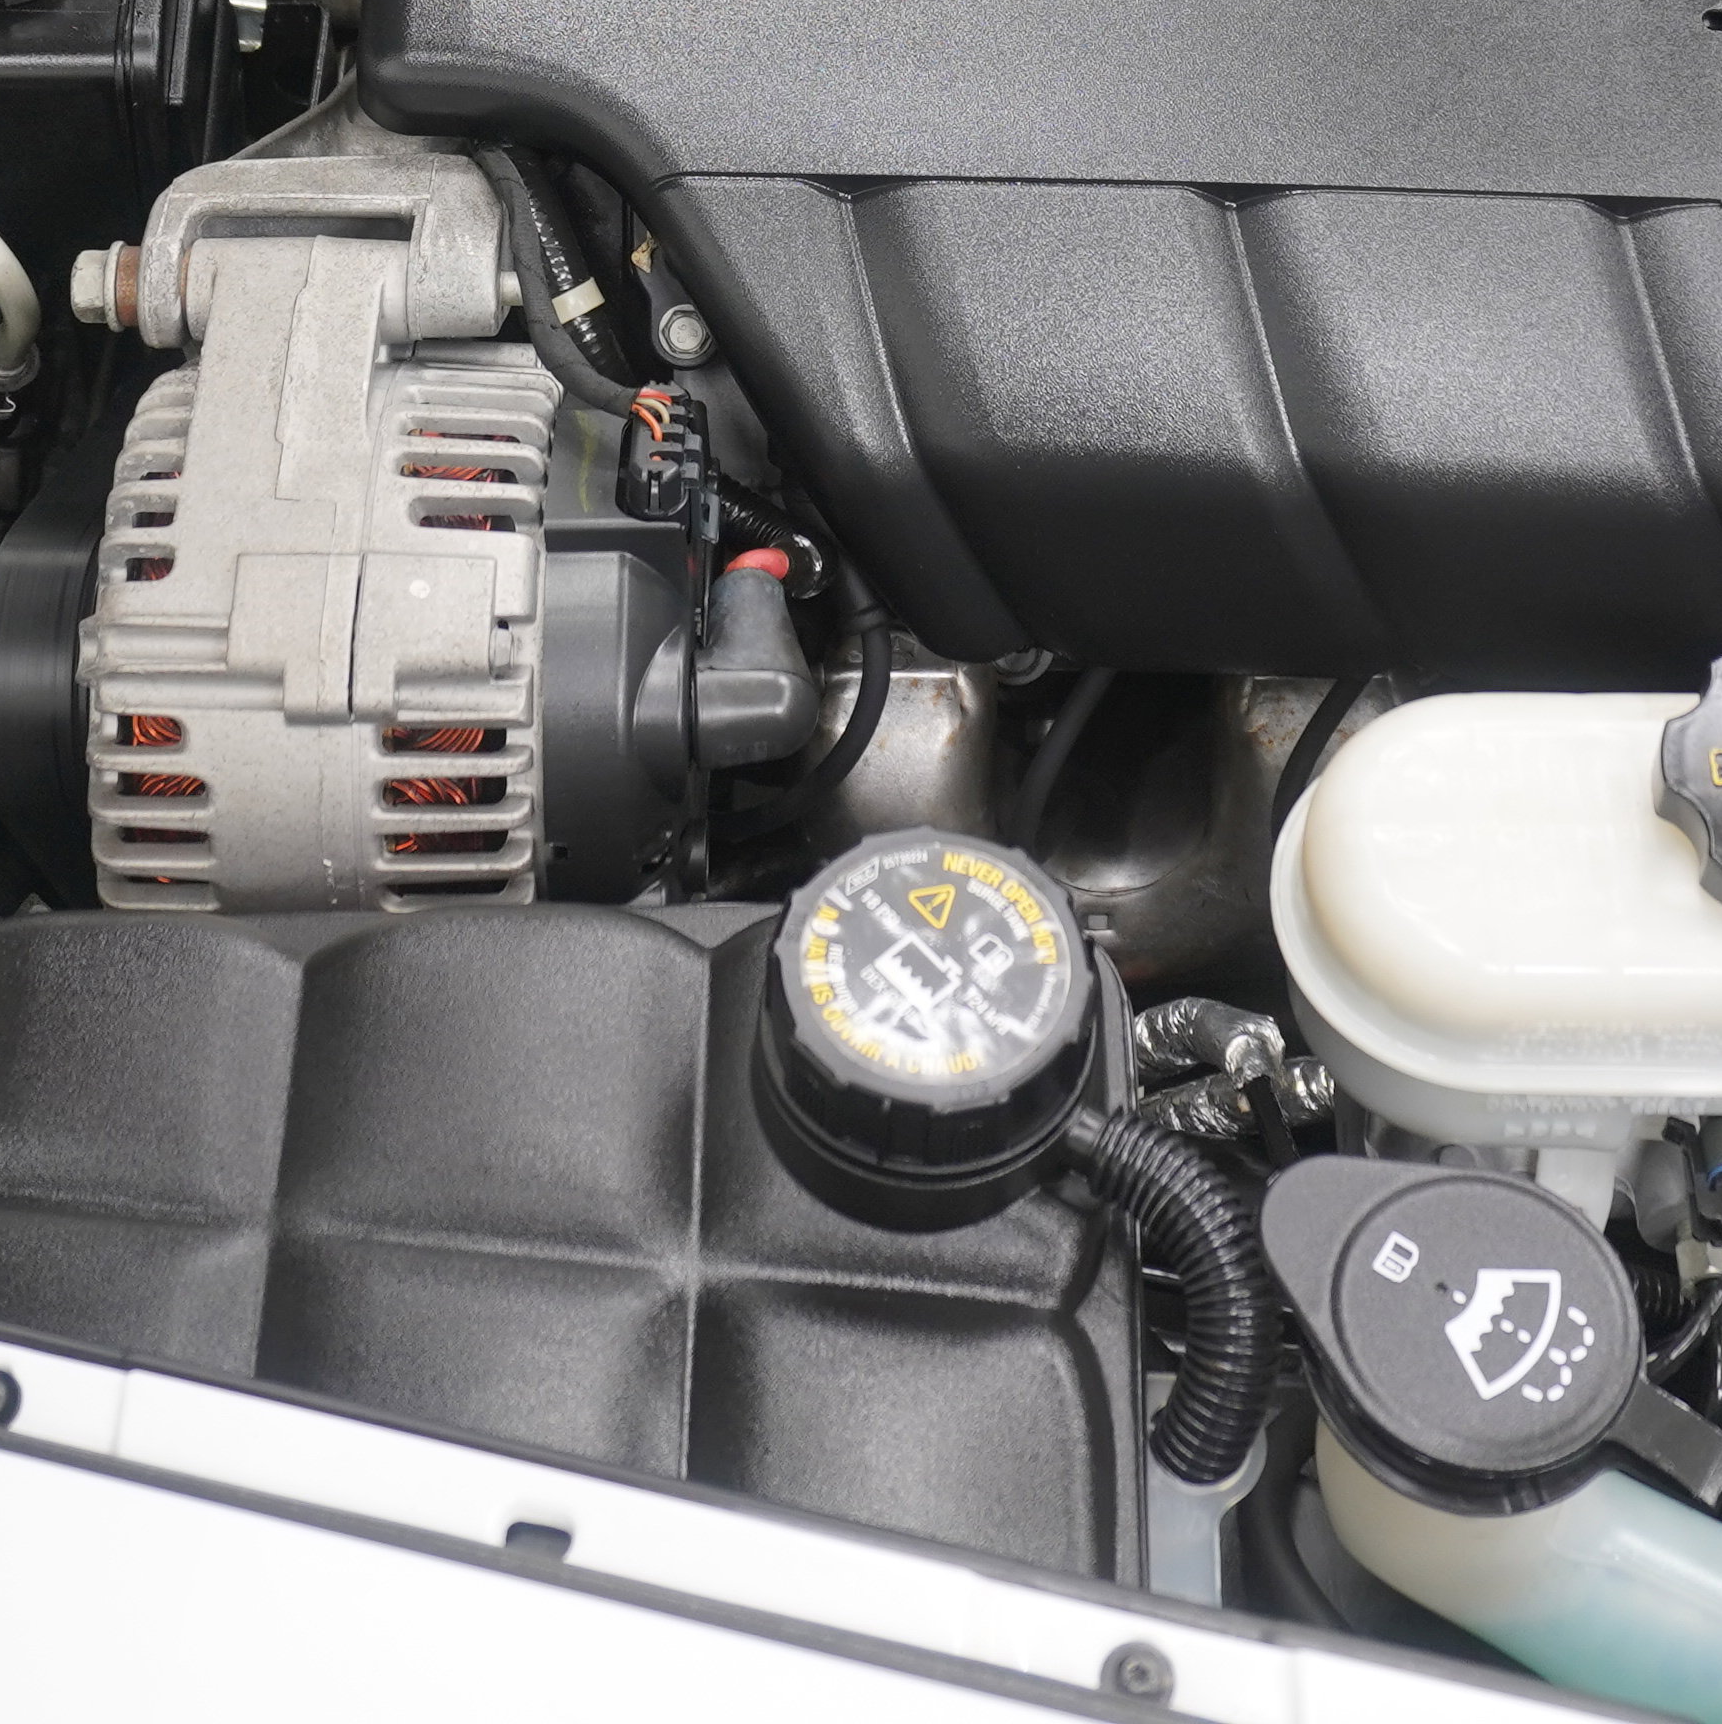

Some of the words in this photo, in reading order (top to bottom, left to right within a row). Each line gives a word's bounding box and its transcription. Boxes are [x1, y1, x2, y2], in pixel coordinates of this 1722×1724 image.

[861, 888, 882, 911] 18
[942, 852, 1004, 888] NEVER
[1000, 879, 1045, 925] OPEN
[966, 877, 1008, 912] SURGE
[1001, 906, 1030, 941] TANK
[812, 904, 842, 937] N
[806, 936, 835, 1005] JAIS
[822, 1007, 883, 1062] OUVIR
